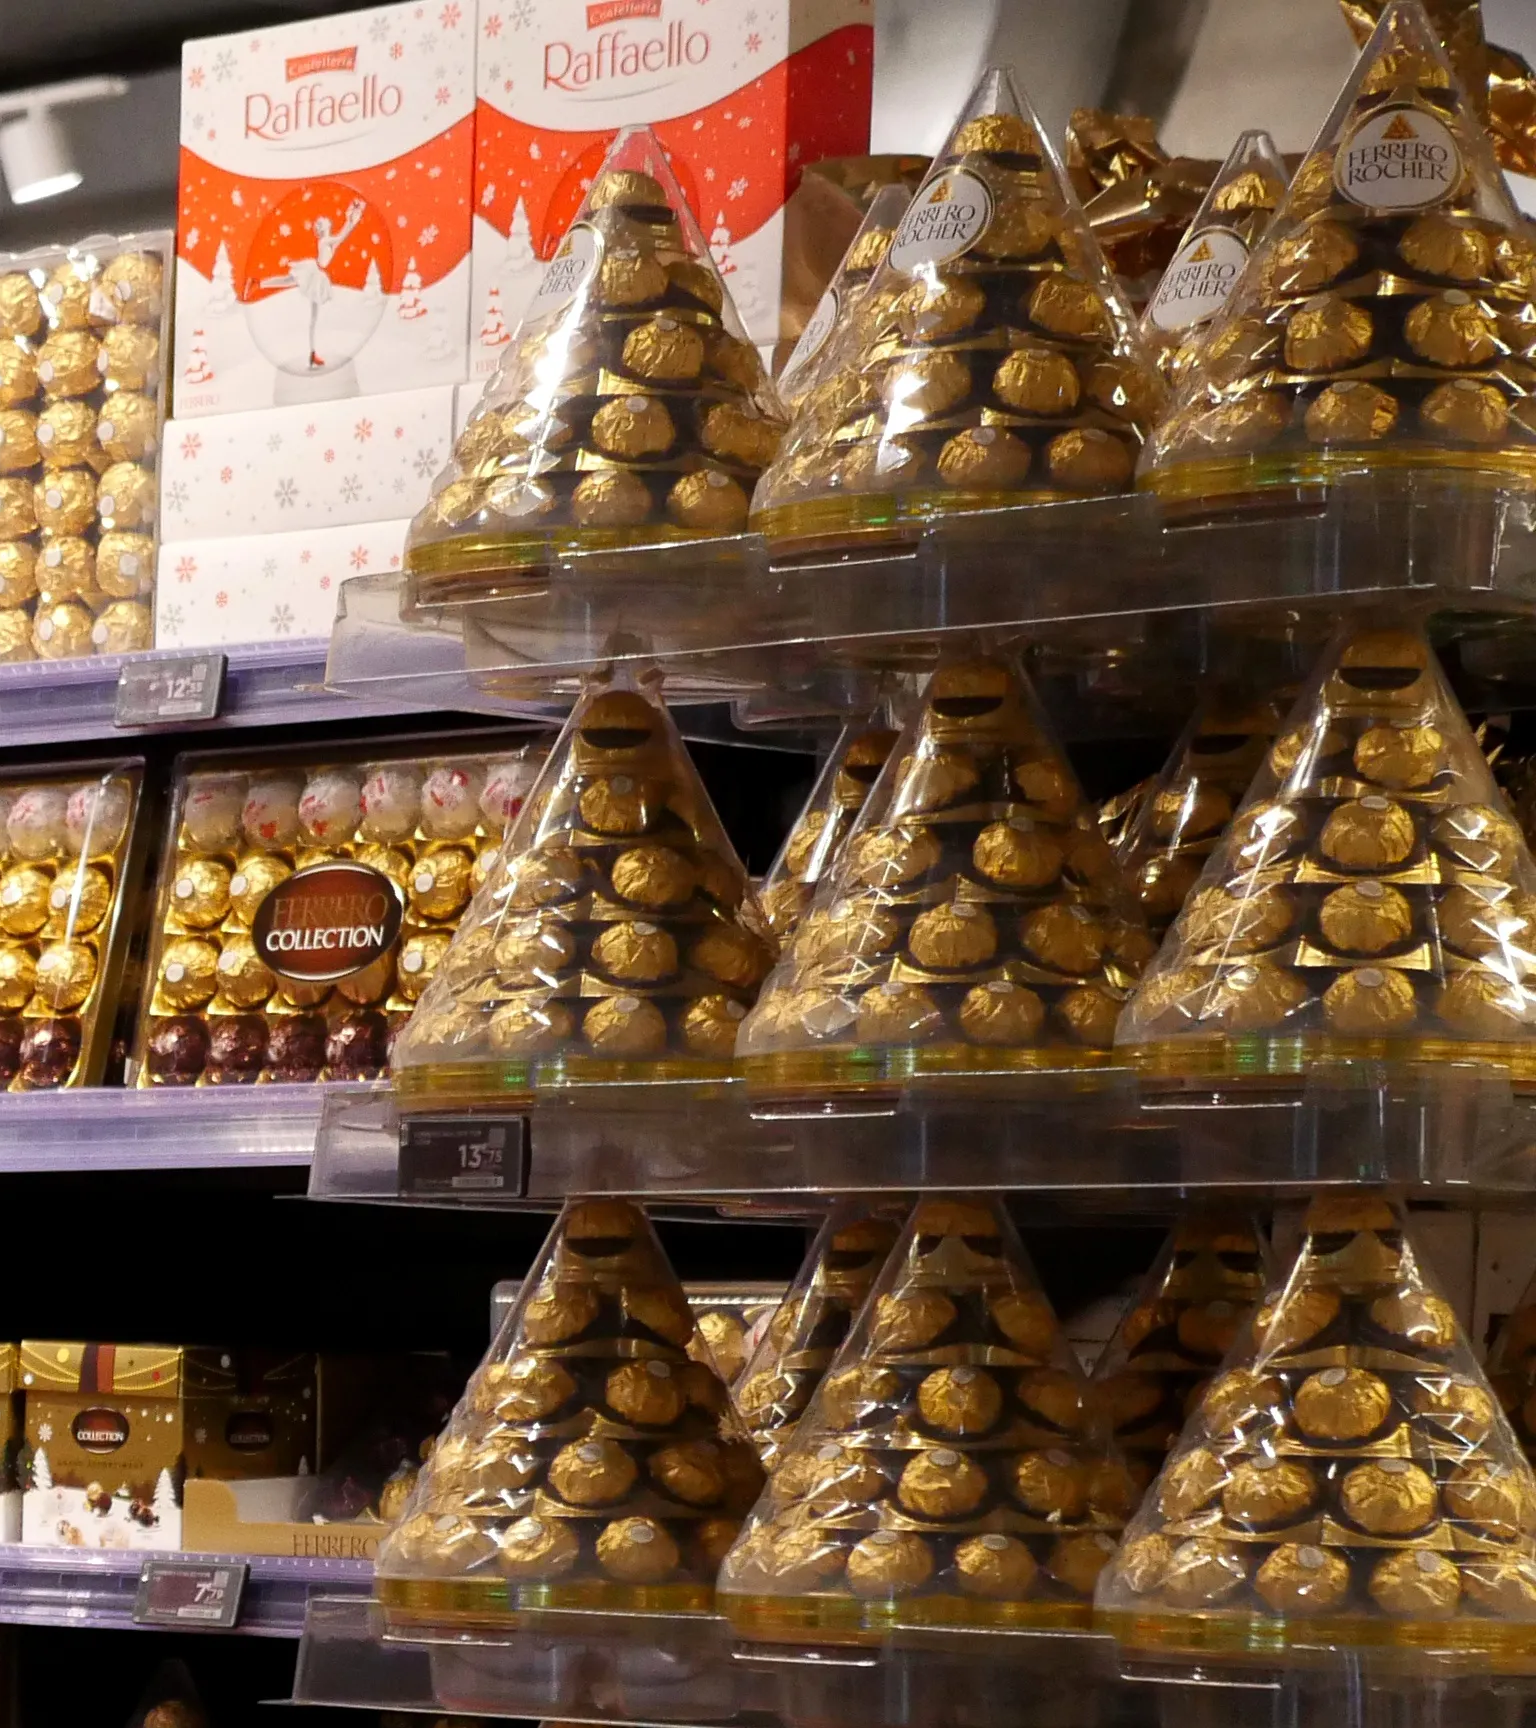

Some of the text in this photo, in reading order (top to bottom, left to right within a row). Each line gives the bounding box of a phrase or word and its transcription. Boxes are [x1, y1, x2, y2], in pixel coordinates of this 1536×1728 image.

[543, 22, 710, 91] Raffaello
[244, 79, 403, 142] Raffaello
[1348, 144, 1448, 169] FERRERO
[1348, 160, 1447, 184] ROCHER
[266, 926, 384, 953] COLLECTION
[76, 1429, 124, 1445] COLLECTION
